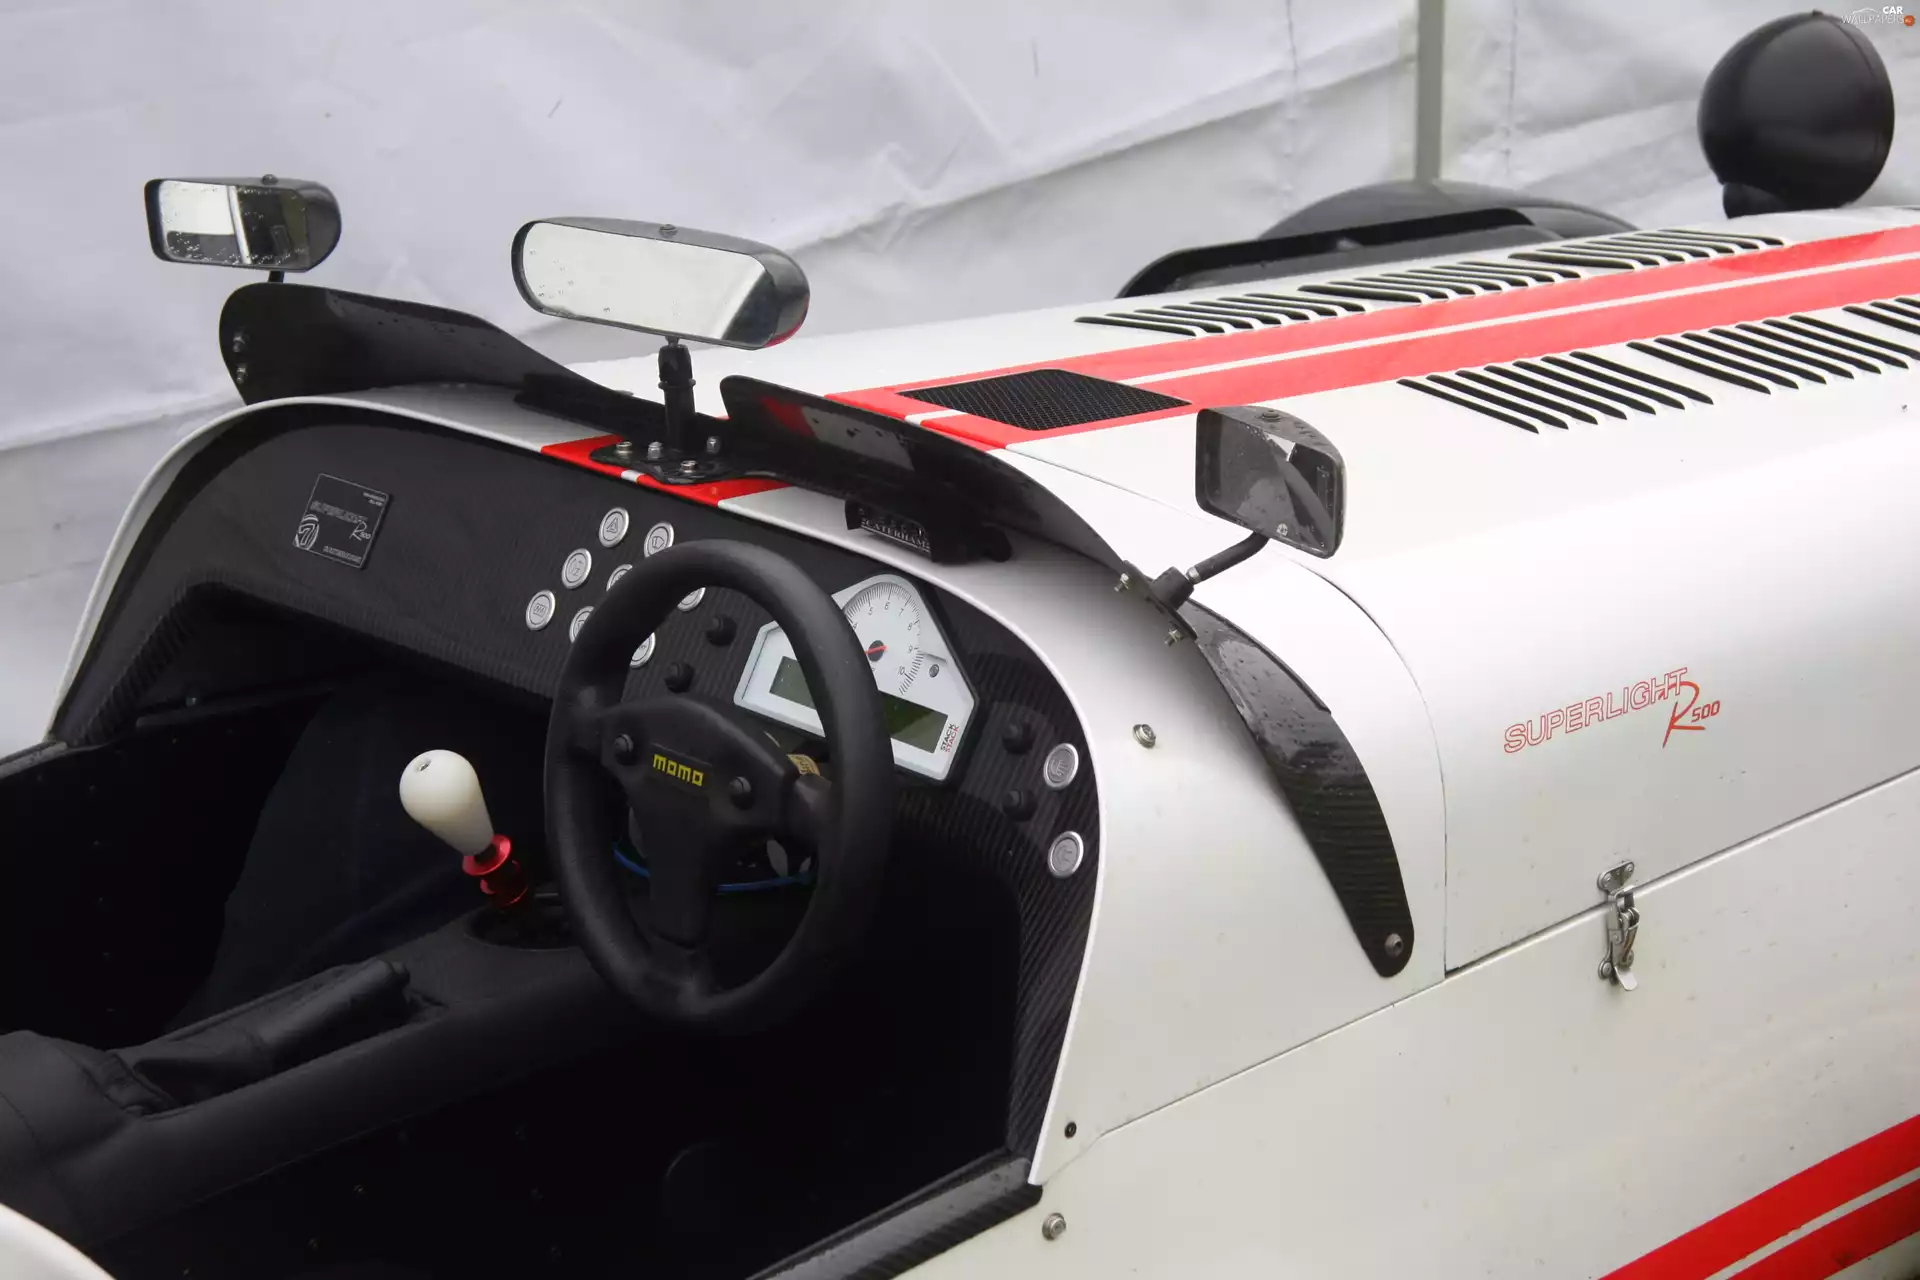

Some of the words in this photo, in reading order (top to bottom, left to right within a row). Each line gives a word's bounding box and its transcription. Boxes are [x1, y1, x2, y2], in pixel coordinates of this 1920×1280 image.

[1503, 667, 1688, 753] SUPERLIGHT
[940, 723, 955, 751] STACK
[945, 725, 959, 753] STACK
